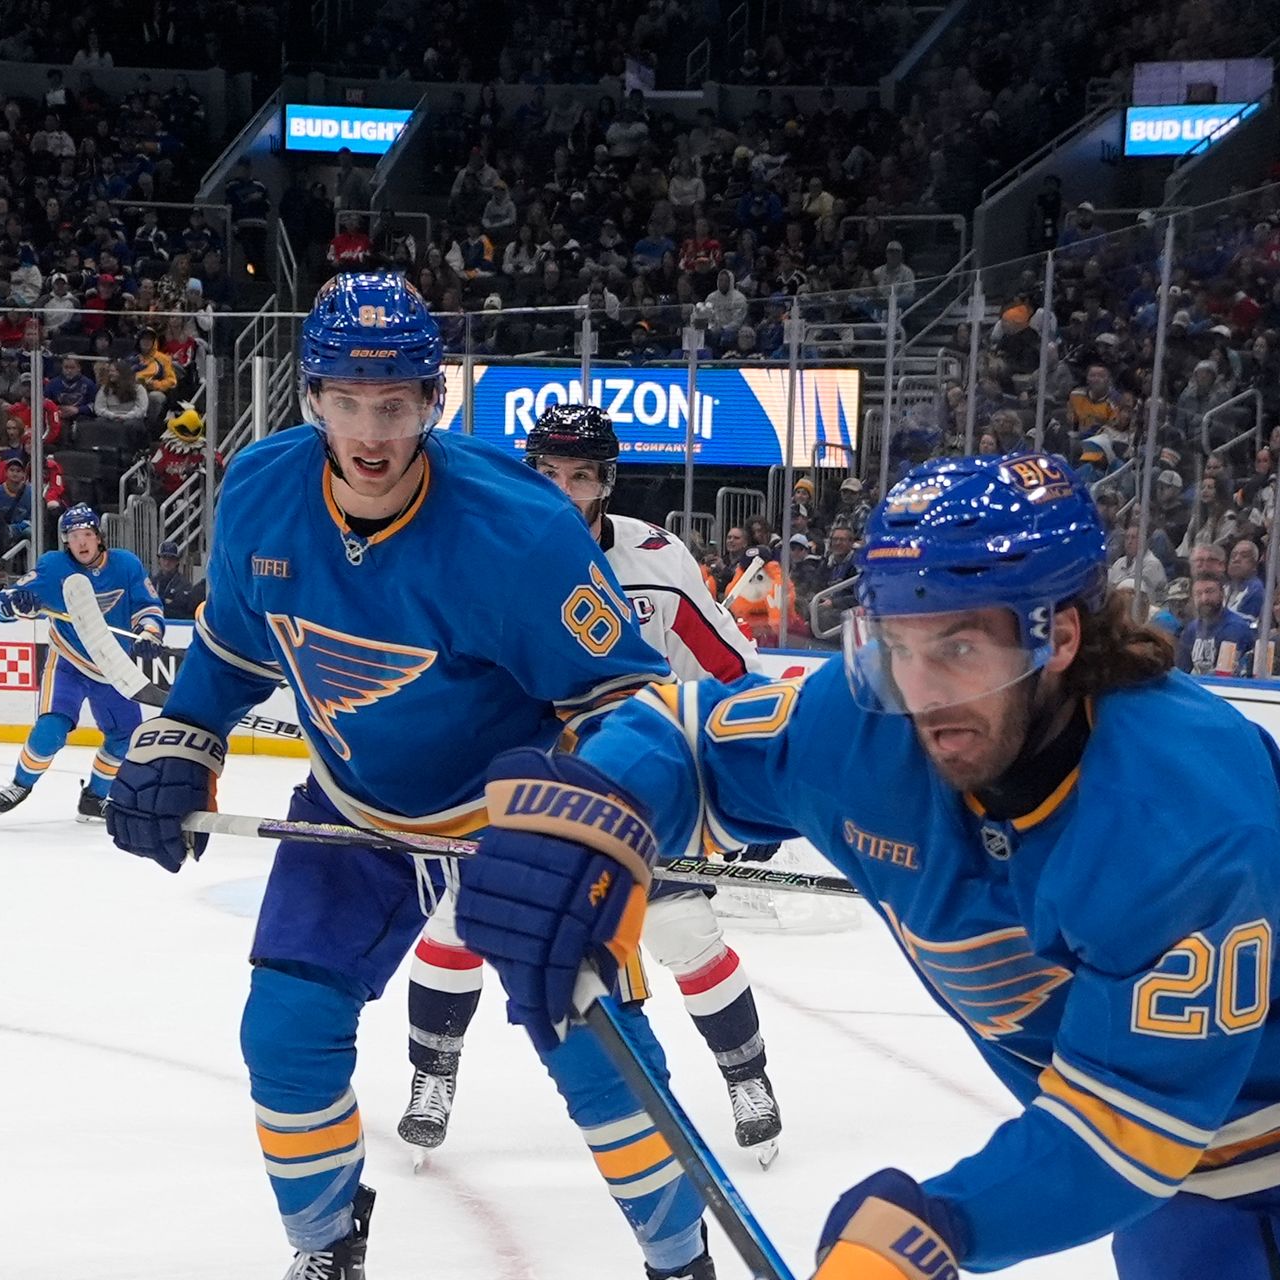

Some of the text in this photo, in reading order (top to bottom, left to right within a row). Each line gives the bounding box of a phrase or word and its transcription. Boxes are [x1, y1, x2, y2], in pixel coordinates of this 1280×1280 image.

[290, 117, 339, 138] BUD
[1130, 120, 1181, 141] BUD
[358, 305, 387, 328] 81
[349, 349, 398, 358] BAUER
[634, 442, 688, 453] COMPANY
[561, 560, 632, 657] 81
[843, 818, 920, 871] STIFEL
[665, 857, 822, 889] BAUER
[1131, 918, 1272, 1039] 20
